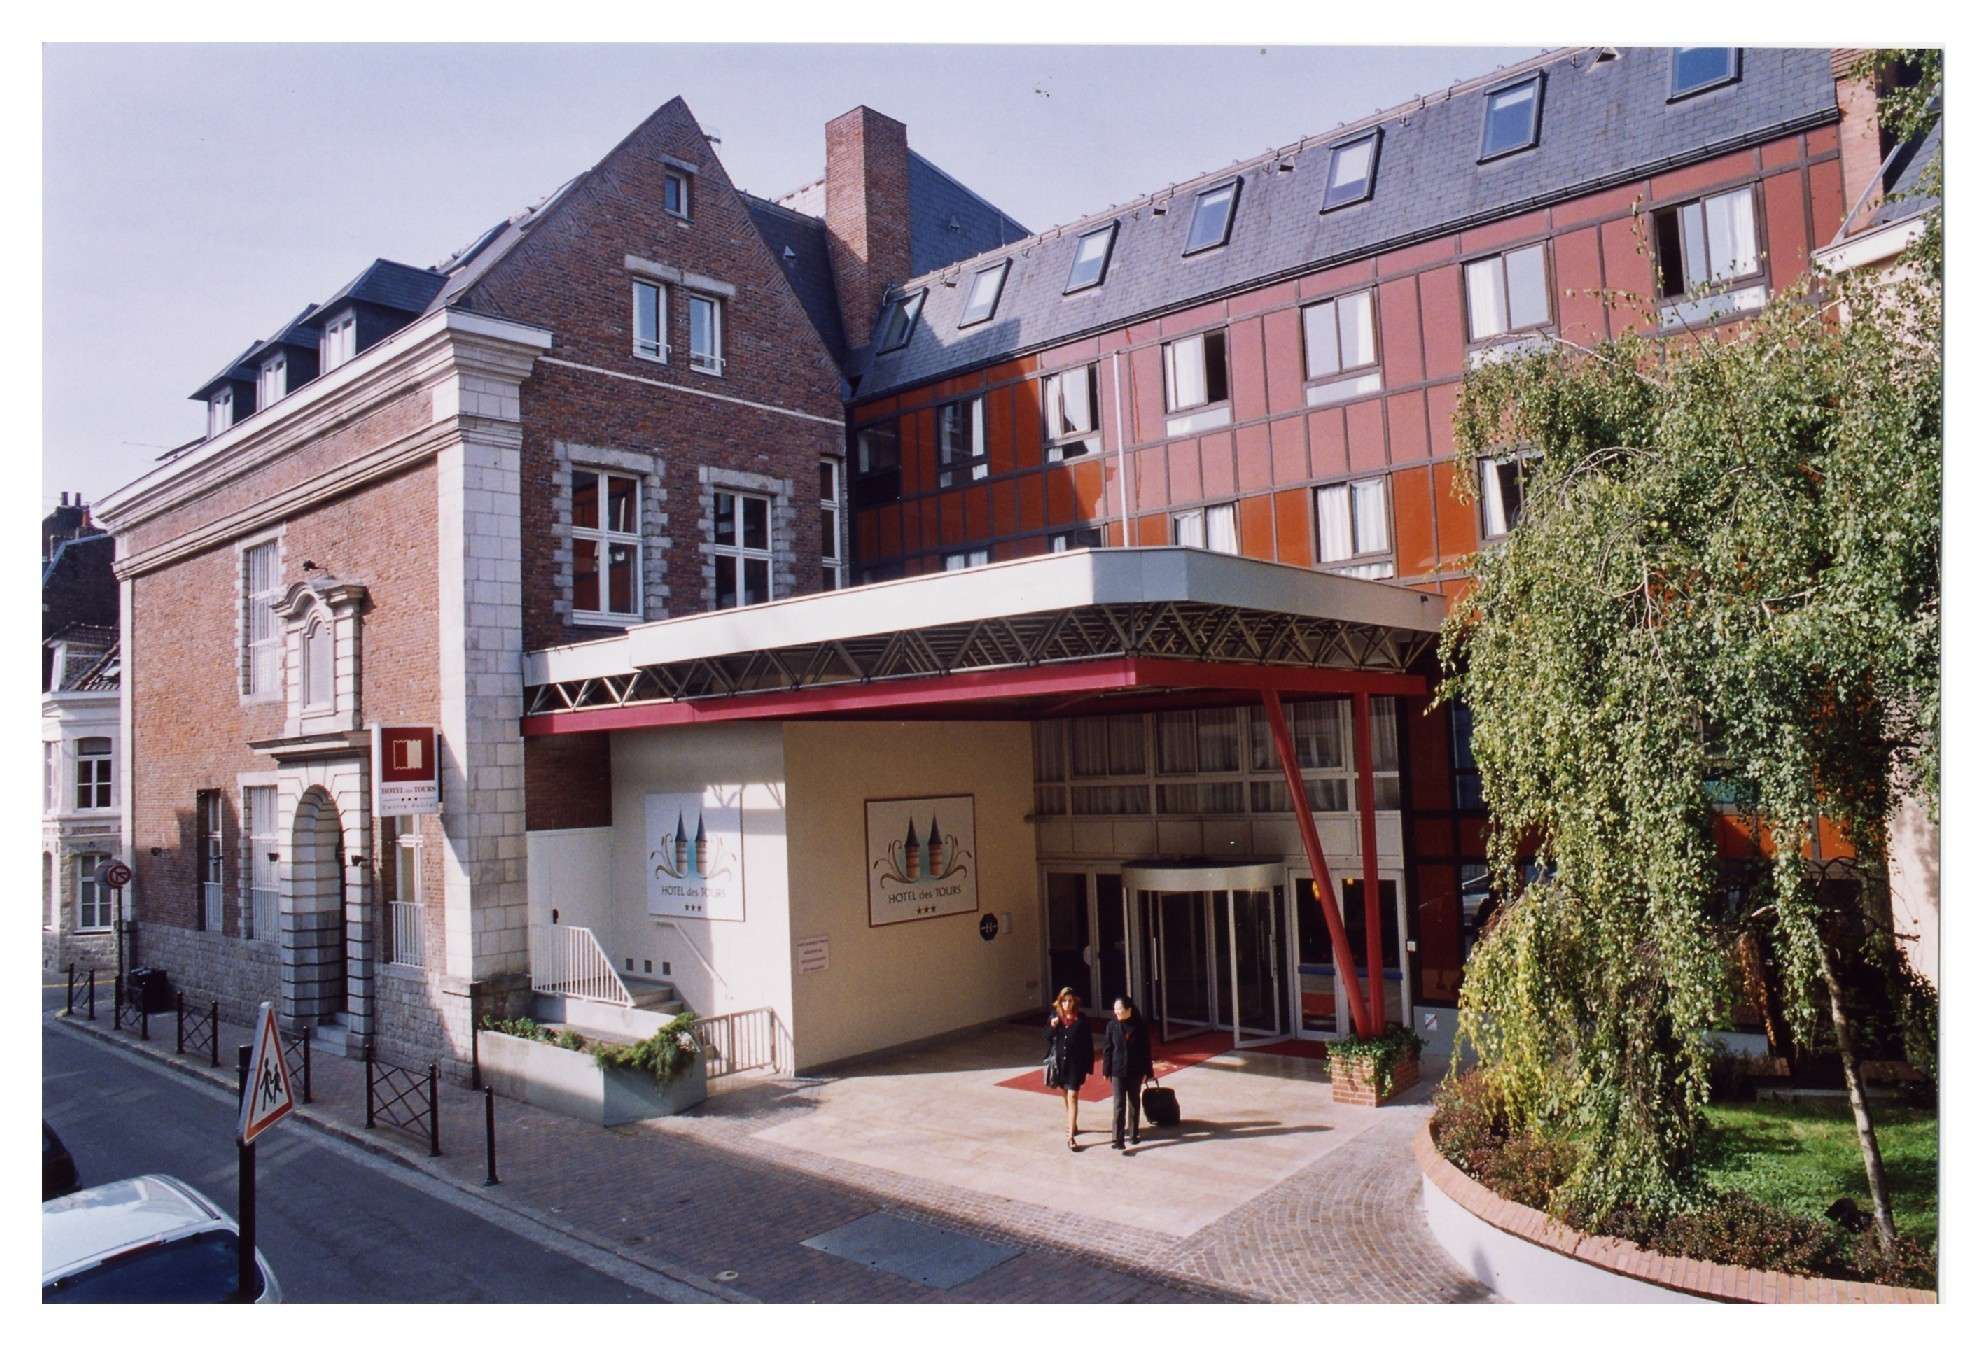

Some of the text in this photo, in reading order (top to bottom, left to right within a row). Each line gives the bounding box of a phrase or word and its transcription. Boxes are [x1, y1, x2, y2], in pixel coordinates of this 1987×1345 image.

[661, 885, 685, 897] HOTEL
[686, 887, 699, 897] des
[888, 884, 962, 904] HOTEL des TOURS
